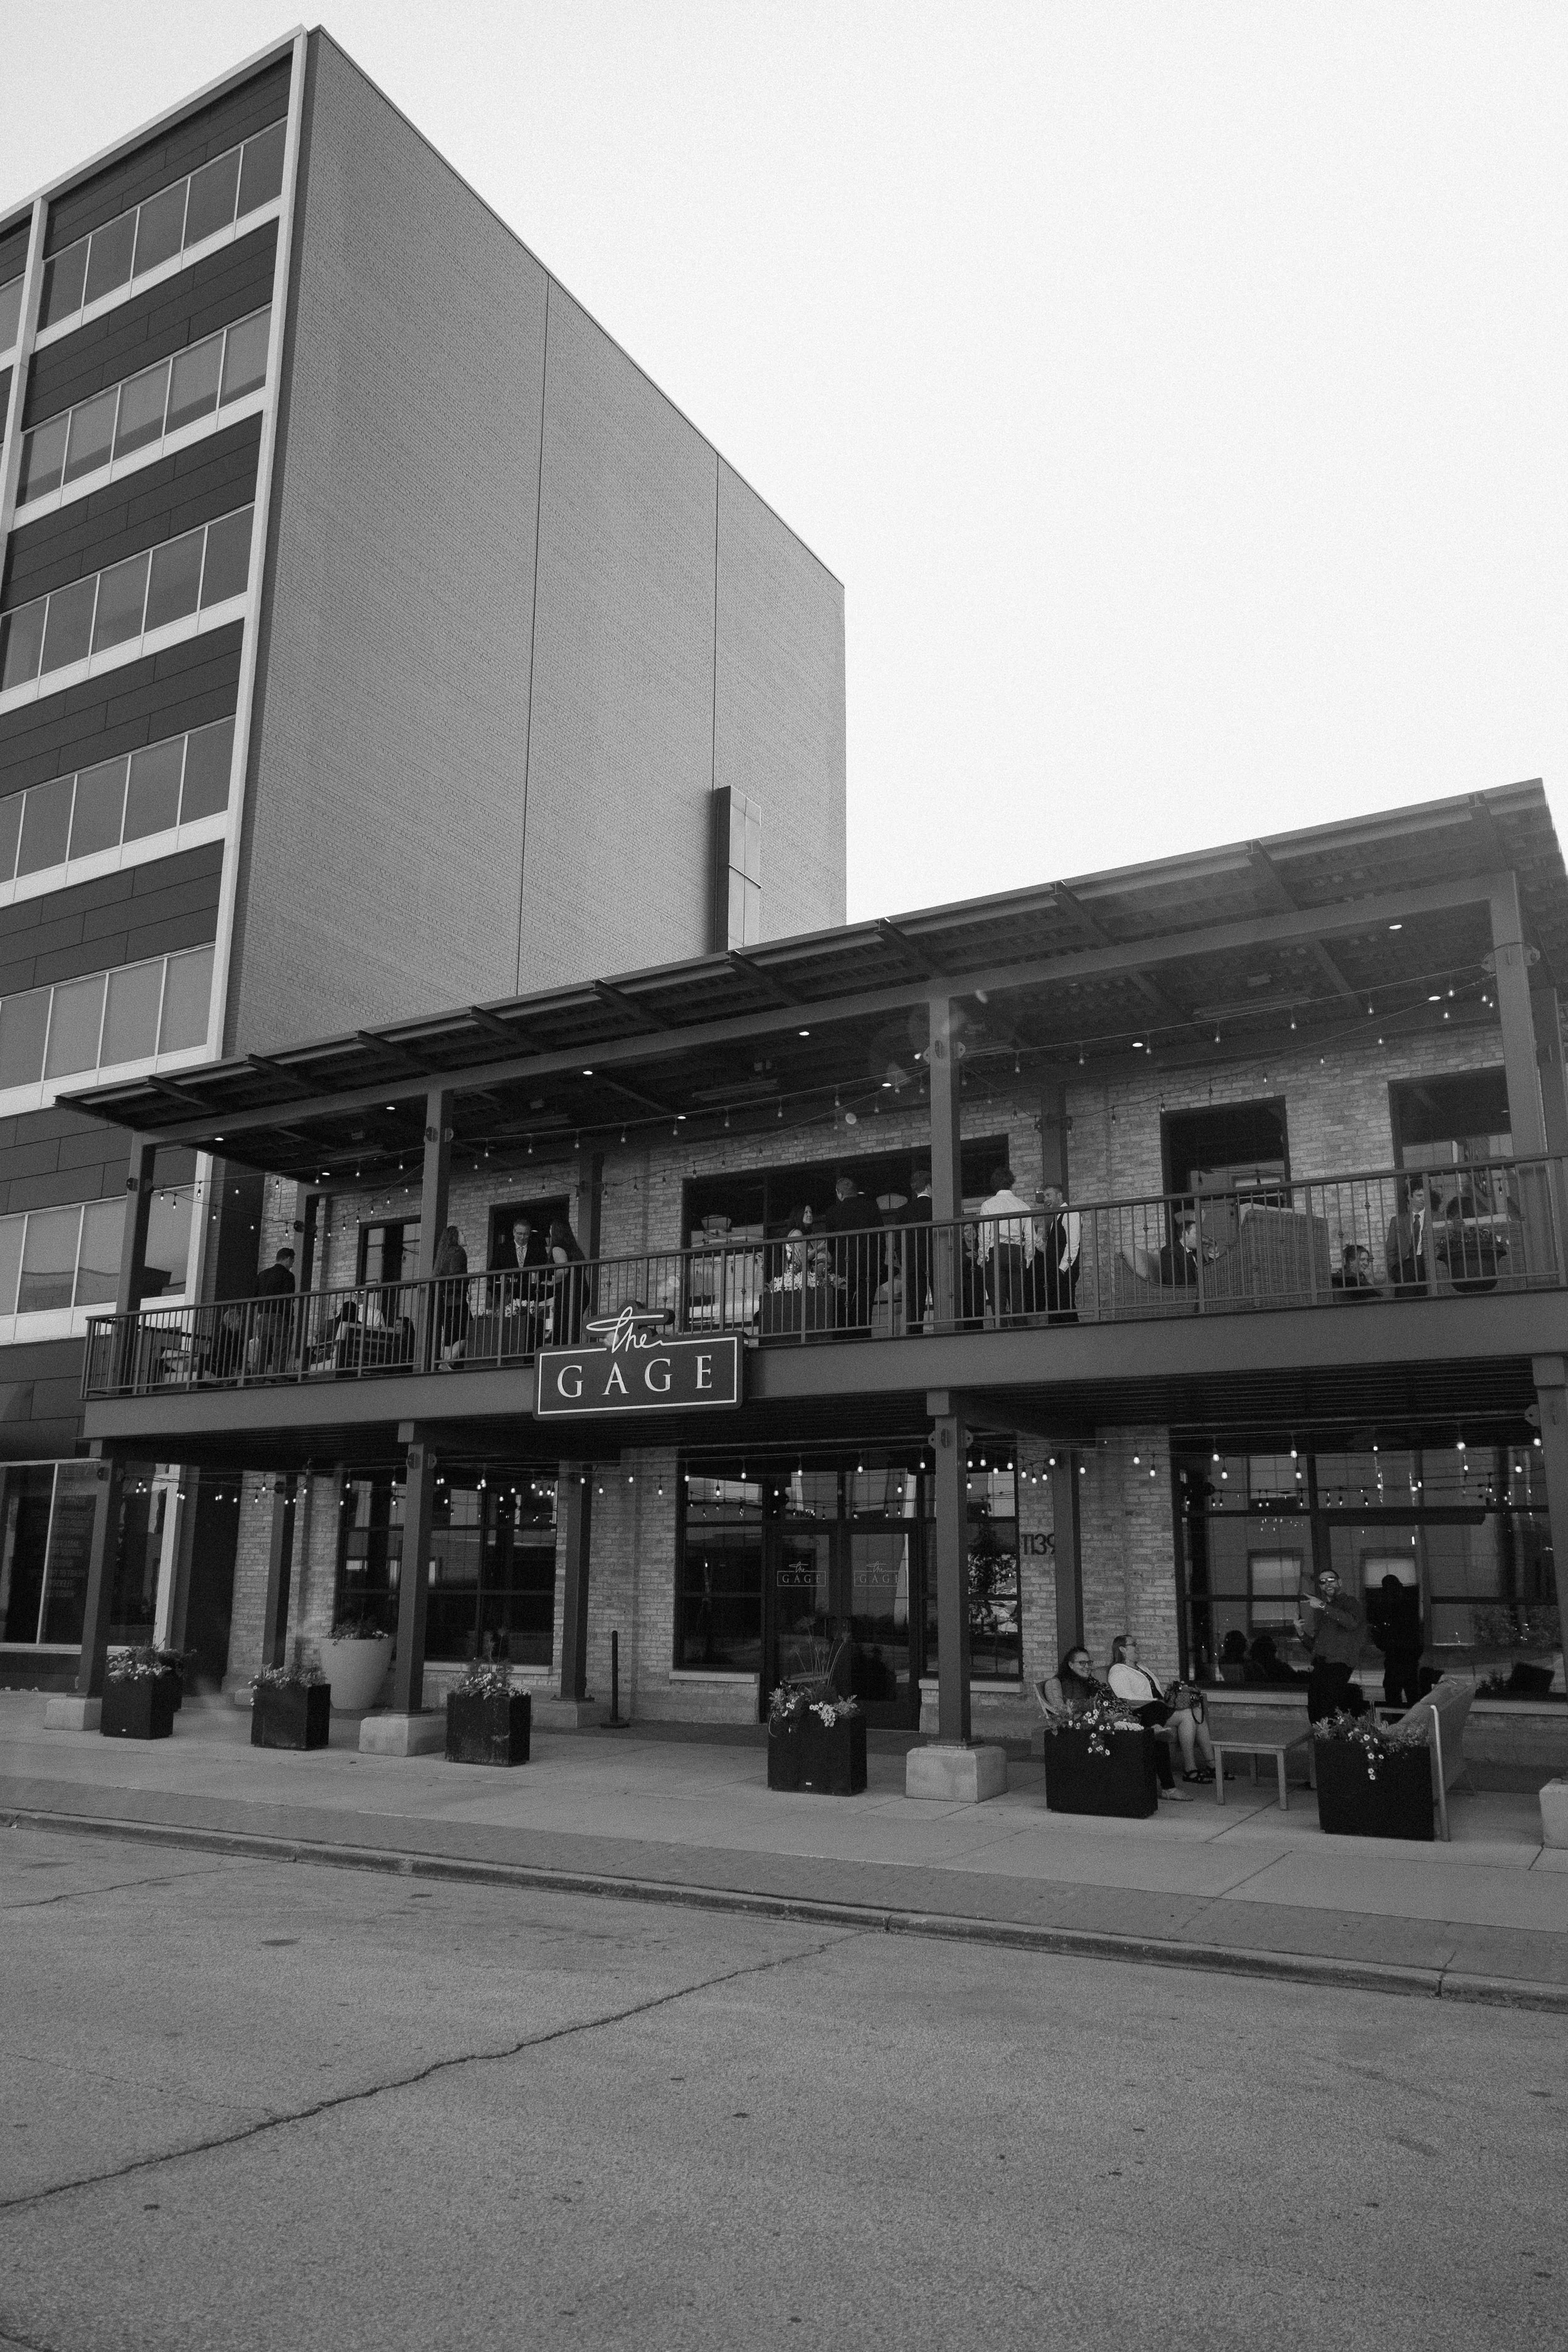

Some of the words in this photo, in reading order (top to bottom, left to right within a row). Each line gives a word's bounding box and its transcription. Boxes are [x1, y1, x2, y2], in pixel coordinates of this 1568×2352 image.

[556, 1355, 713, 1398] GAGE
[1020, 1533, 1055, 1555] 1139
[782, 1574, 821, 1583] GAGE
